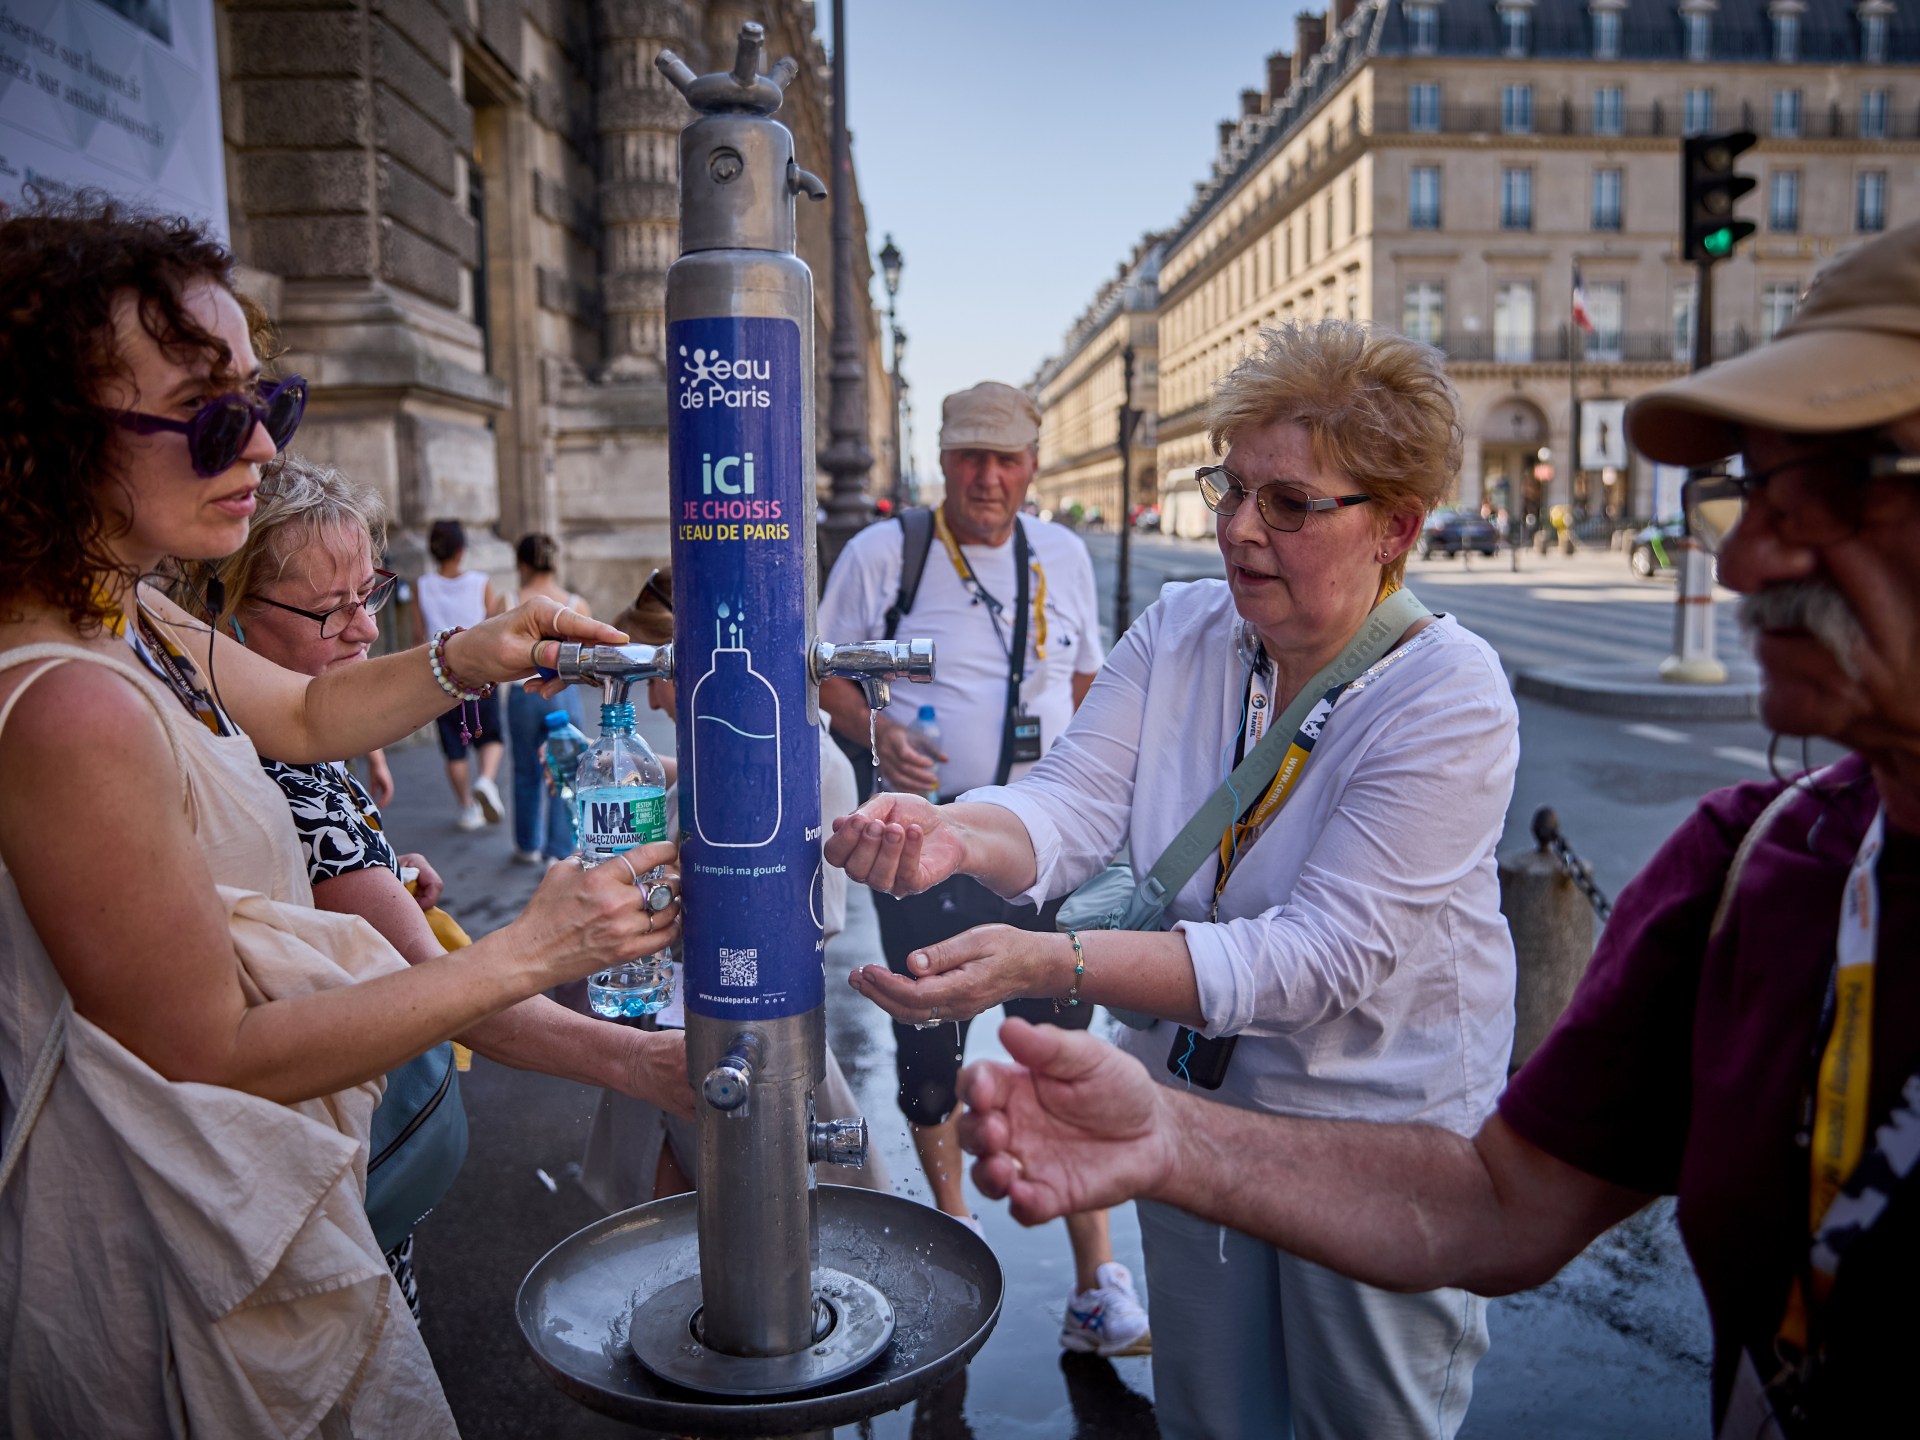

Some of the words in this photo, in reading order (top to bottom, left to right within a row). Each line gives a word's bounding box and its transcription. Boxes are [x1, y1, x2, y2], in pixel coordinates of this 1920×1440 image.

[714, 359, 770, 380] eau
[680, 387, 704, 409] de
[709, 385, 771, 408] Paris
[683, 501, 698, 519] JE
[679, 524, 713, 541] L'EAU
[717, 524, 739, 541] DE
[1250, 711, 1258, 737] TRAVEL
[592, 802, 636, 833] NAŁ
[585, 832, 648, 846] NAŁĘCZOWIANKA
[694, 862, 701, 873] Je
[702, 865, 734, 877] remplis
[736, 867, 751, 875] ma
[753, 863, 786, 877] gourde
[699, 992, 760, 1005] www.eaudeparis.fr
